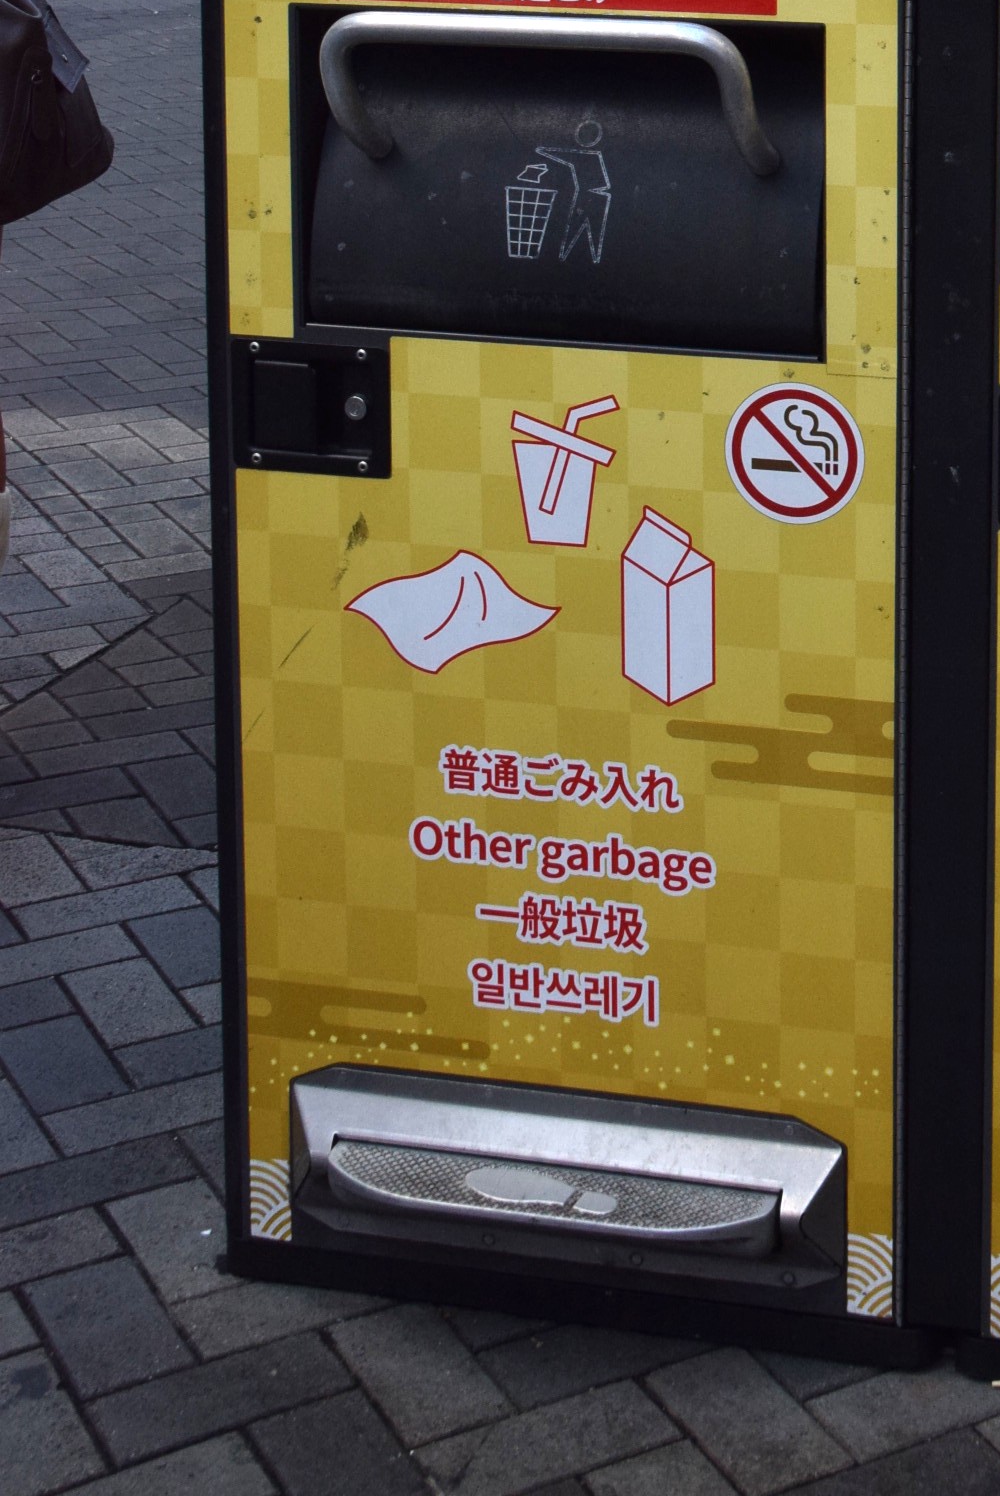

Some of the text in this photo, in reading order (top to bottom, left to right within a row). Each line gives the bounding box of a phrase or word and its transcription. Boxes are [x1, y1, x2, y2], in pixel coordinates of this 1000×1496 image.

[441, 746, 682, 810] 普通ごみ入れ
[411, 818, 713, 893] Other garbage
[478, 894, 646, 951] 一般垃圾
[470, 961, 656, 1023] 일반쓰레기
